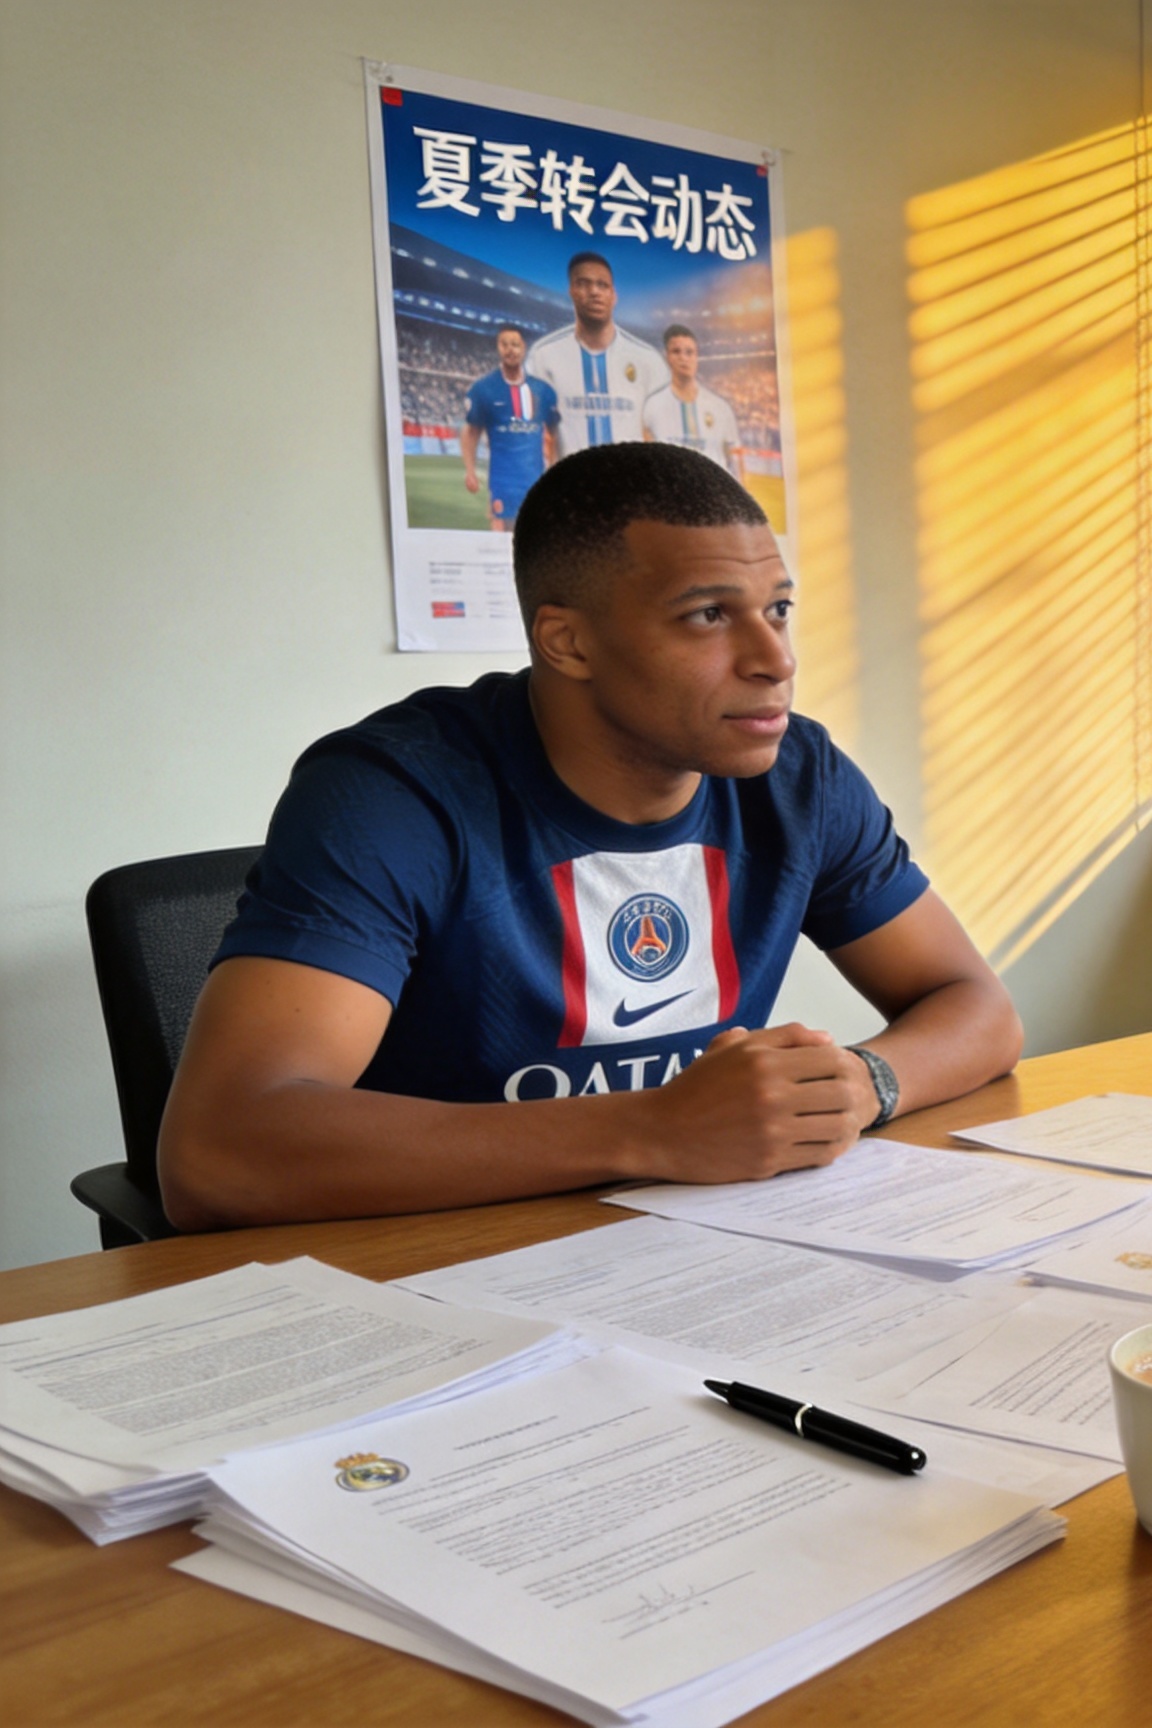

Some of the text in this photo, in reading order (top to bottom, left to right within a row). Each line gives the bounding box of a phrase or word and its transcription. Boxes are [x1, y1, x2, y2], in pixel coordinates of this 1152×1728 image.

[412, 126, 757, 261] 夏季转会动态
